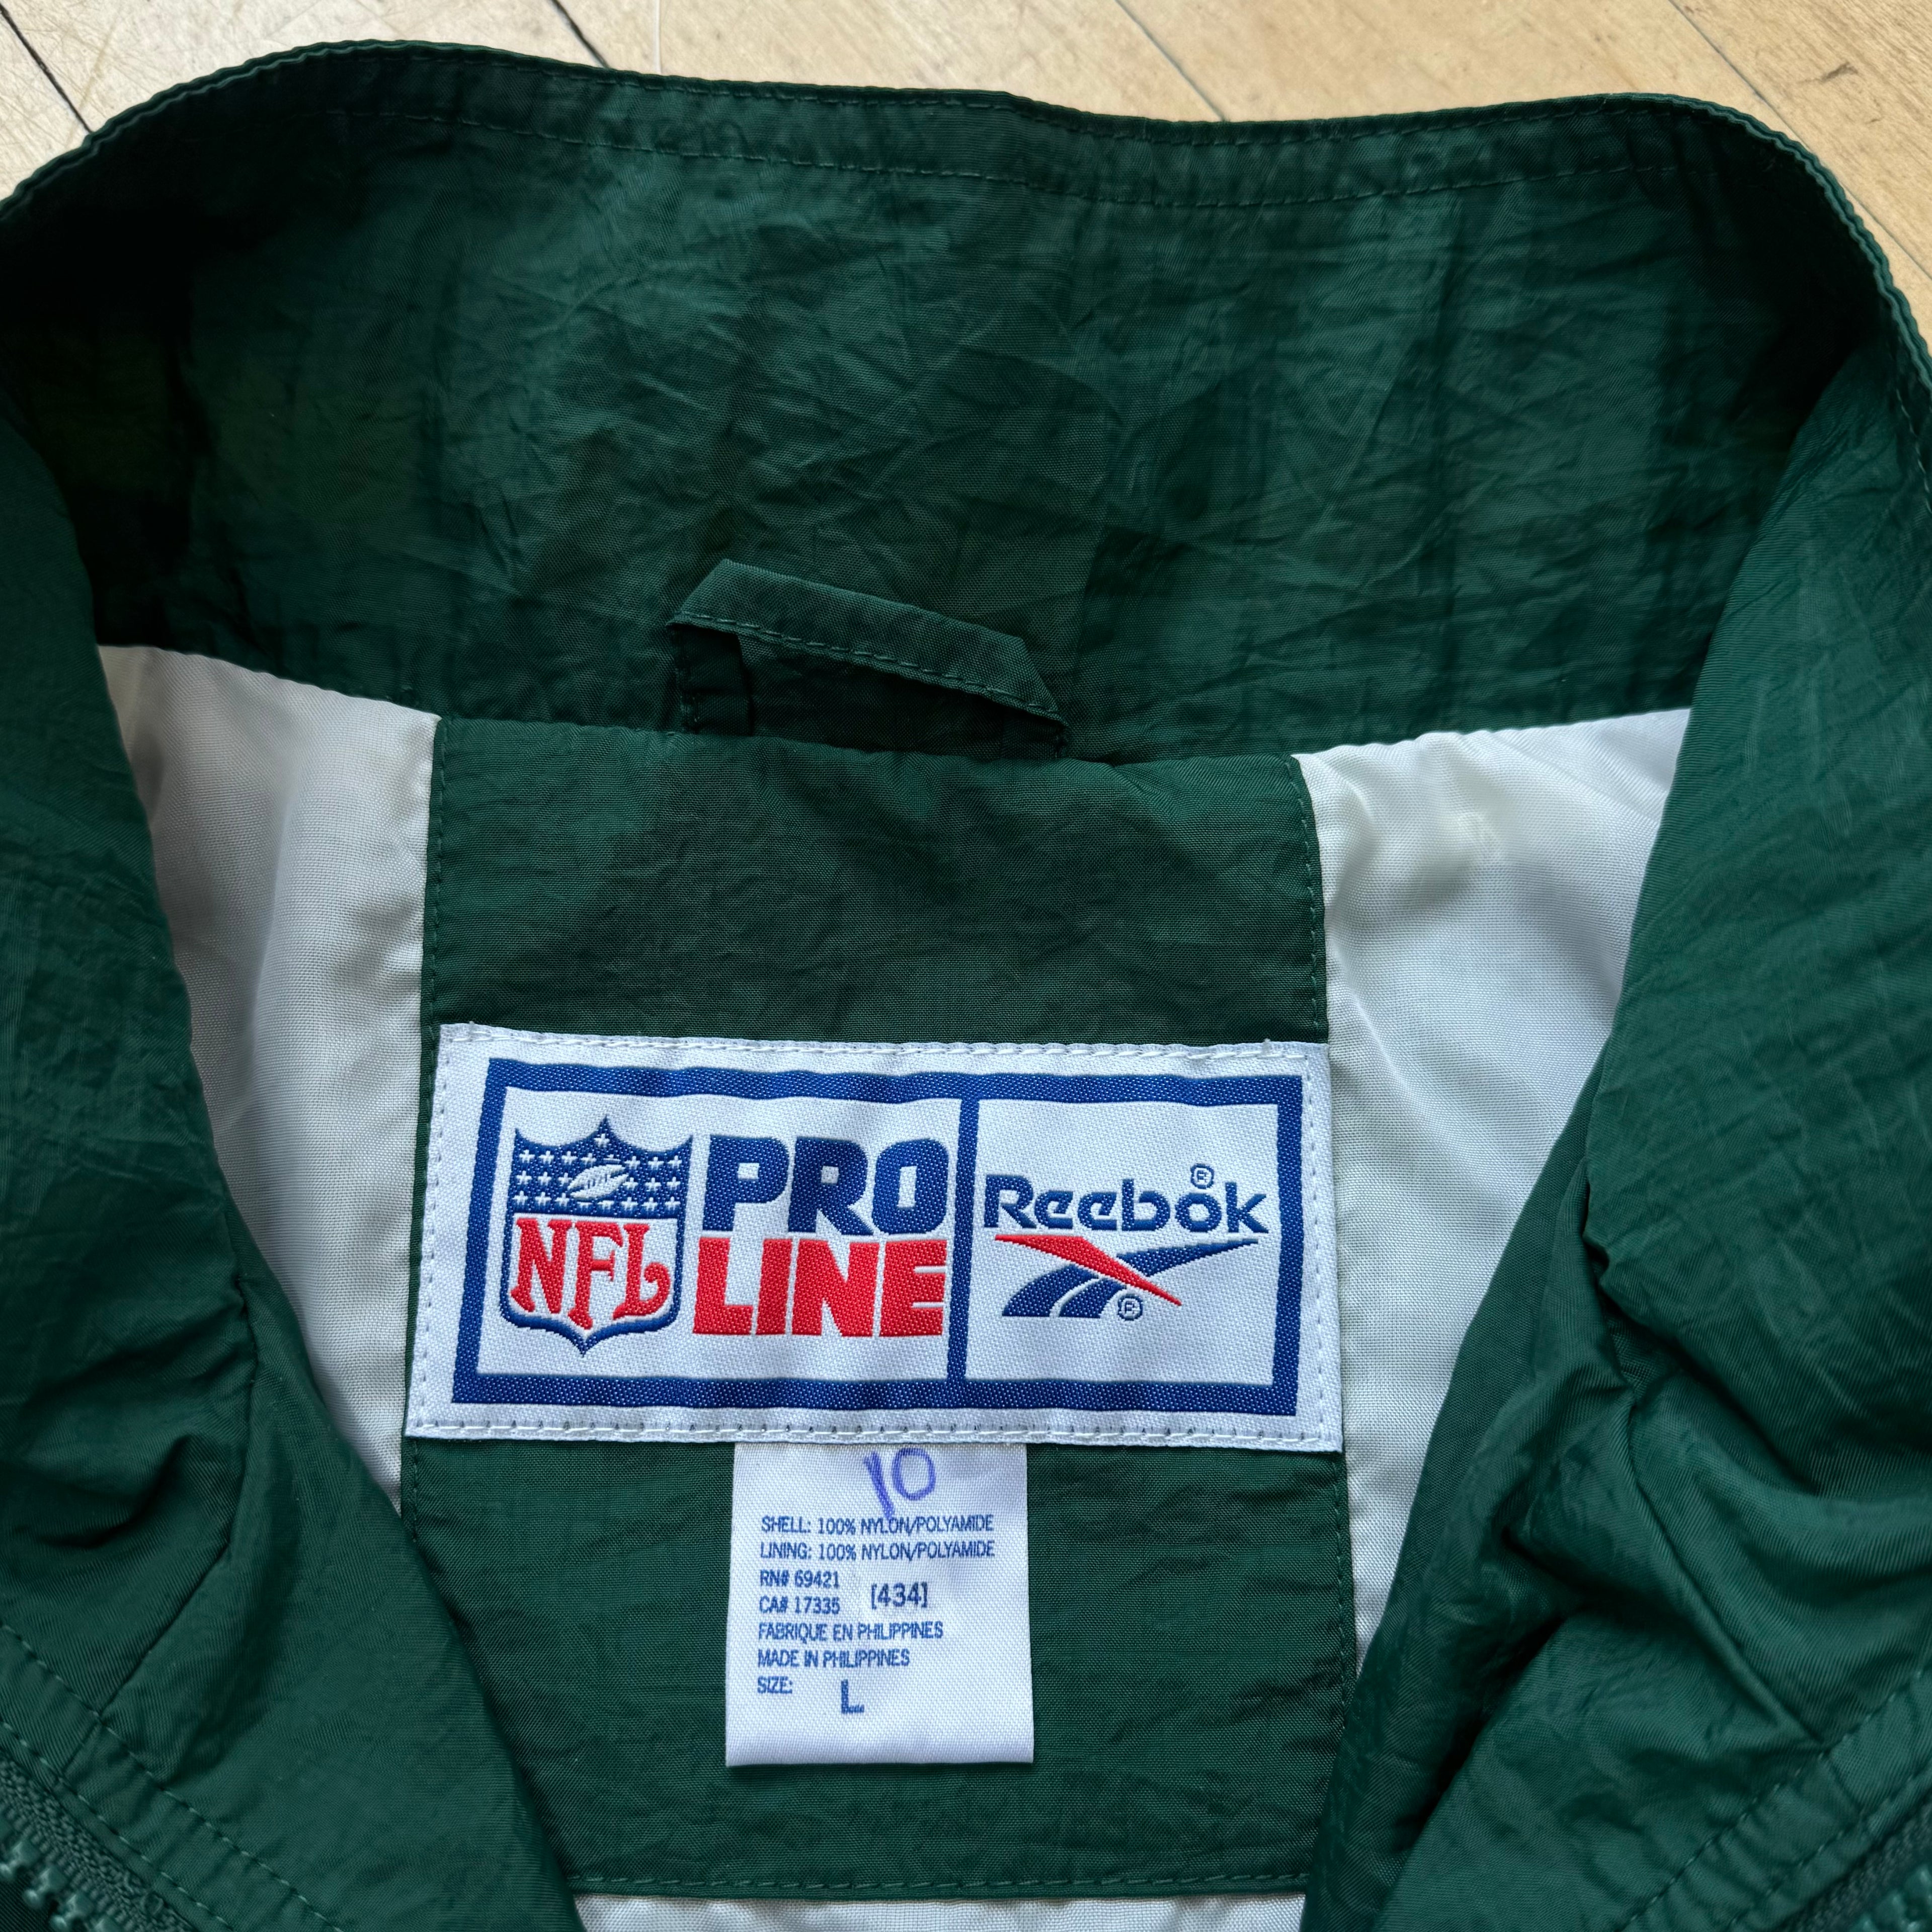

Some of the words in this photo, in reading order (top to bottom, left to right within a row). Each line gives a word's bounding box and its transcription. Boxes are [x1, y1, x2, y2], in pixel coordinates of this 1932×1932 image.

[702, 1134, 949, 1236] PRO
[984, 1174, 1269, 1233] Reebok
[509, 1218, 671, 1330] NFL
[692, 1236, 947, 1337] LINE
[863, 1447, 936, 1520] 10
[761, 1514, 812, 1534] SHELL:
[818, 1515, 855, 1536] 100%
[860, 1514, 994, 1536] NYLON/POLYAMIDE
[760, 1541, 812, 1560] LINING:
[819, 1542, 857, 1561] 100%
[861, 1540, 996, 1563] NYLON/POLYAMIDE
[760, 1569, 789, 1588] RN#
[794, 1570, 840, 1590] 69421
[759, 1595, 789, 1614] CA#
[794, 1596, 841, 1616] 17335
[870, 1581, 931, 1611] [434]
[758, 1622, 828, 1645] FABRIQUE
[832, 1624, 853, 1642] EN
[857, 1621, 944, 1641] PHILIPPINES
[757, 1649, 800, 1668] MADE
[803, 1649, 819, 1668] IN
[823, 1648, 911, 1668] PHILIPPINES
[757, 1675, 793, 1695] SIZE:
[840, 1678, 865, 1715] L
